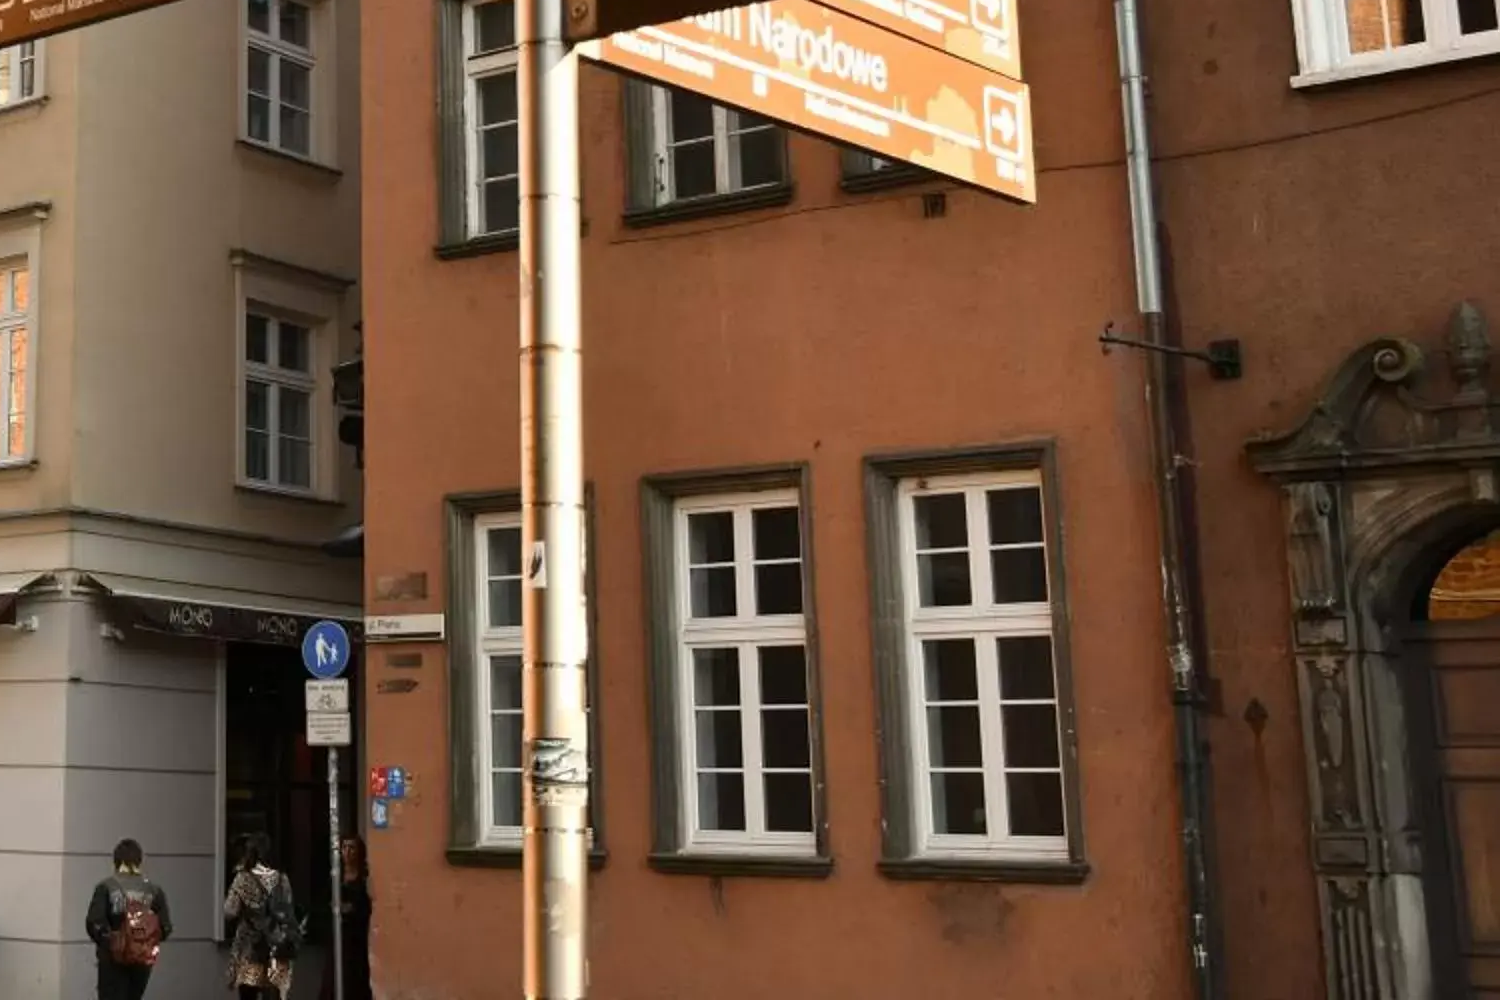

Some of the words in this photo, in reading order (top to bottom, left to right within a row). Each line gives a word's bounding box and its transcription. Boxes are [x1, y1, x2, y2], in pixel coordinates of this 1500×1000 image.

[29, 0, 65, 23] National
[749, 2, 888, 92] Narodowe
[169, 605, 213, 629] MONO
[257, 615, 298, 637] MONO
